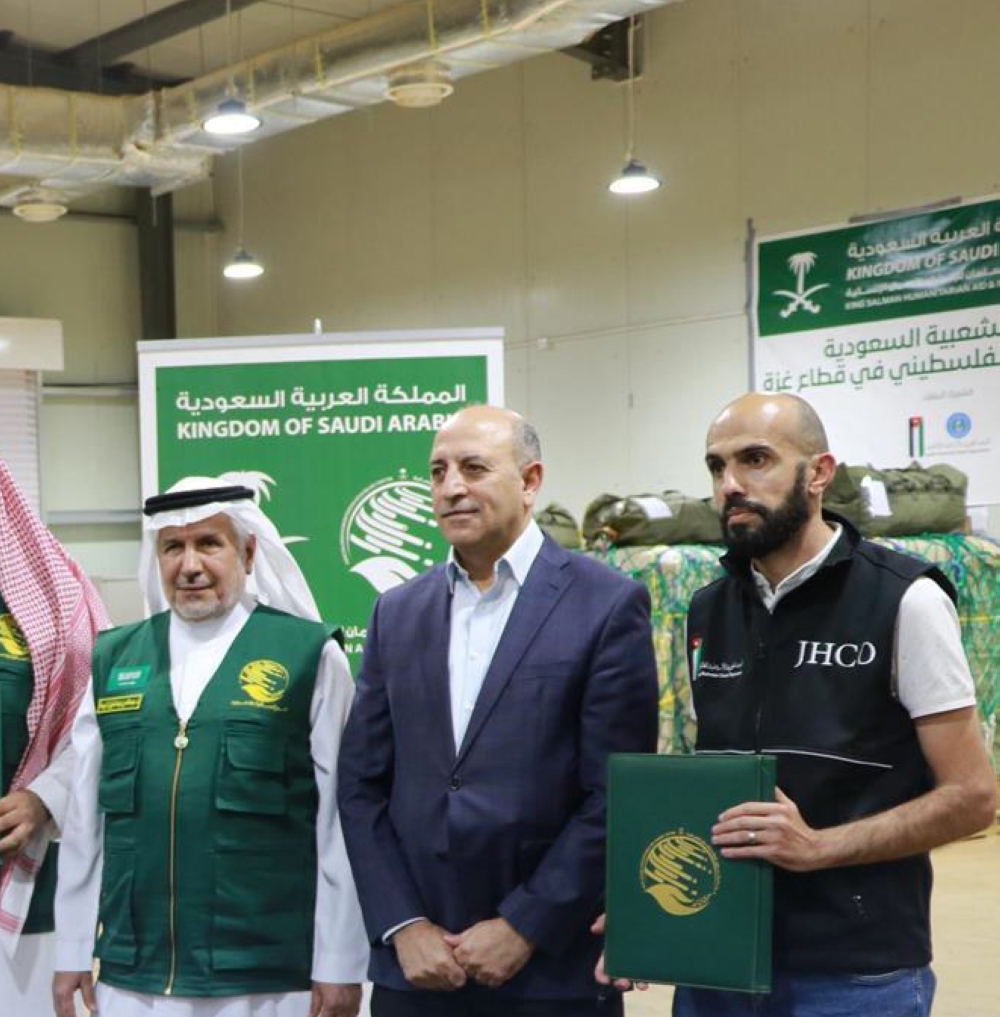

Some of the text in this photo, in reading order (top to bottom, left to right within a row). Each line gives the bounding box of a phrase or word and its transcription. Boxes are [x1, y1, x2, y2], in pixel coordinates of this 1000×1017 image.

[846, 243, 998, 280] KINGDOM OF SAUDI
[824, 327, 921, 361] السعودية
[763, 370, 792, 392] غزة
[798, 364, 846, 392] قطاع
[850, 360, 884, 390] في
[176, 383, 467, 416] المملكة العربية السعودية
[177, 412, 452, 439] KINGDOM OF SAUDI ARAB
[794, 639, 877, 667] JHCO
